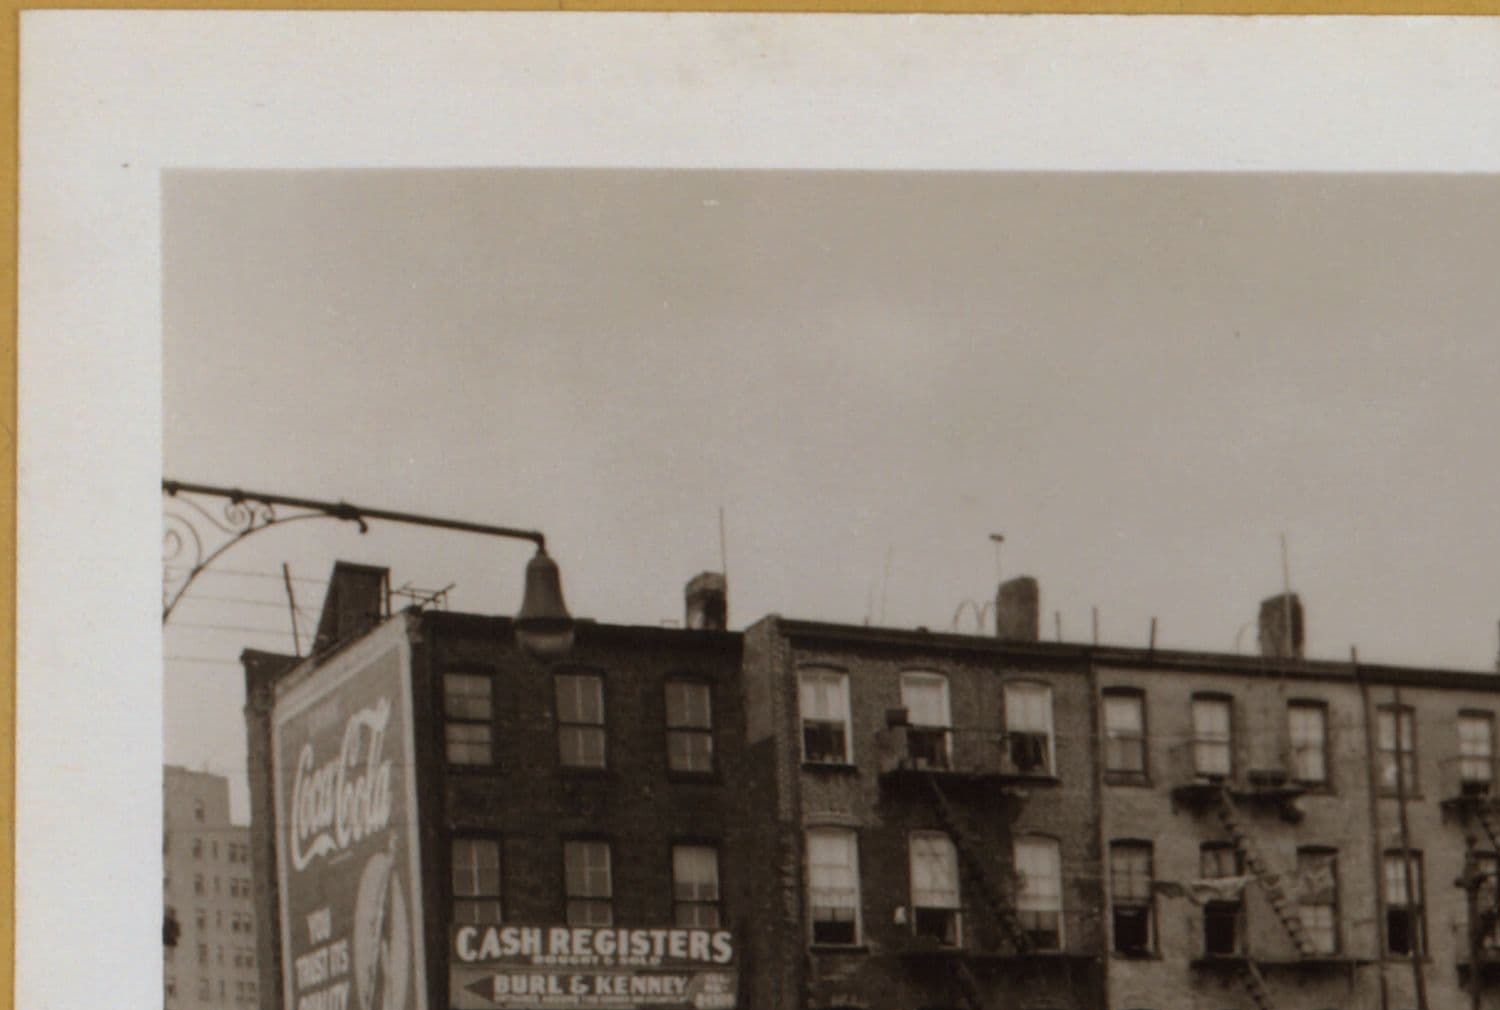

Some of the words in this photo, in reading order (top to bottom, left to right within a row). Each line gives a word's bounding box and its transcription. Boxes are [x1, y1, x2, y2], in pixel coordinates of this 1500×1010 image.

[456, 926, 542, 962] CASH
[548, 926, 734, 964] REGISTERS
[494, 973, 563, 995] BURL
[569, 973, 590, 996] &
[595, 974, 688, 996] KENNEY
